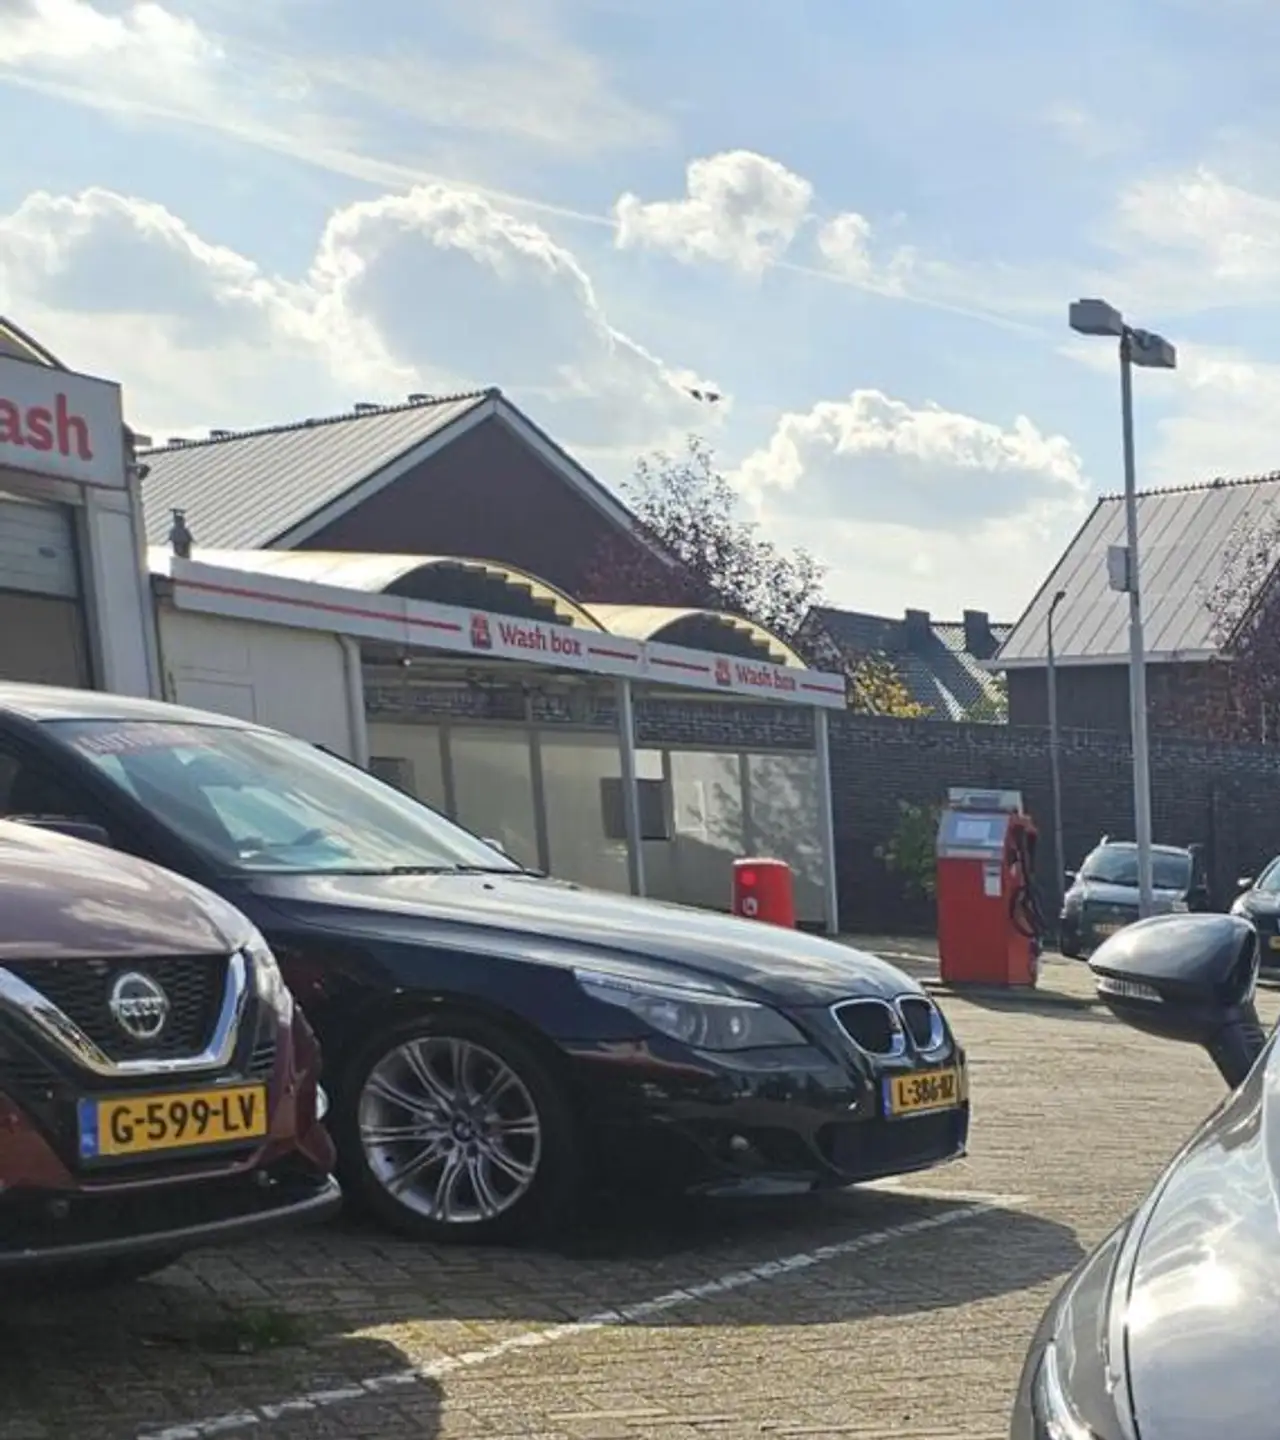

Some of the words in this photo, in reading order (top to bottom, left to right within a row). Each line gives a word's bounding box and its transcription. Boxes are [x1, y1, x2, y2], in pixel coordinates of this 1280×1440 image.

[498, 621, 548, 651] Wash
[550, 627, 583, 656] box
[735, 663, 773, 687] Wash
[773, 667, 796, 691] box
[110, 1094, 257, 1145] G-599-LV
